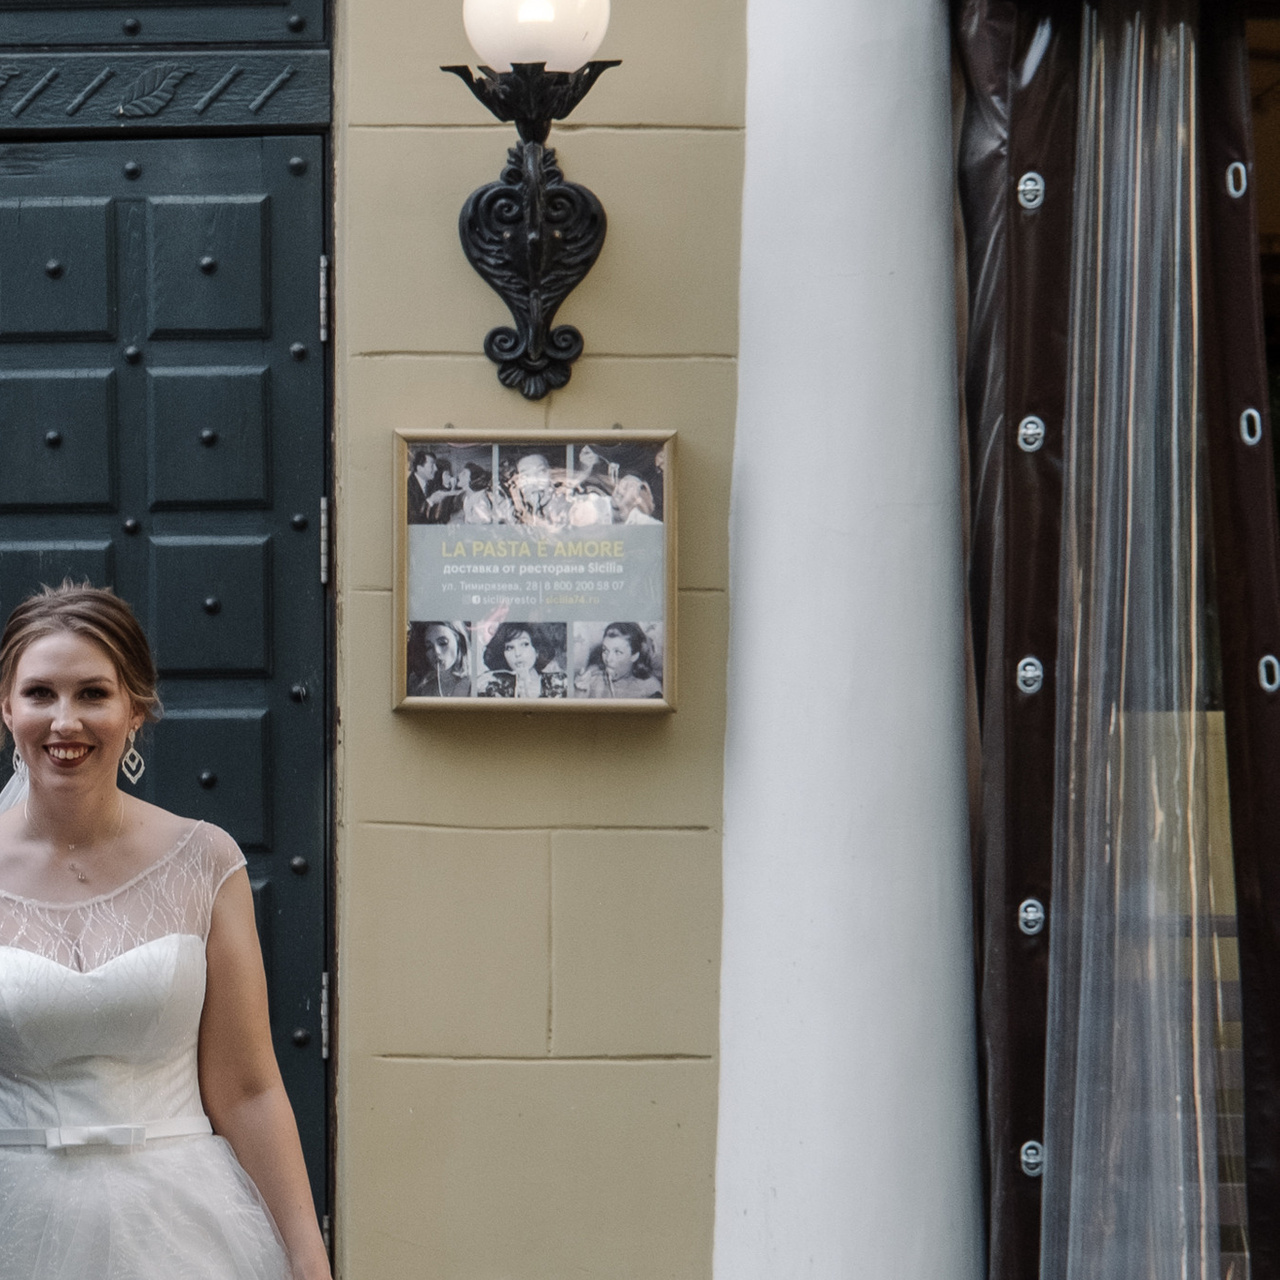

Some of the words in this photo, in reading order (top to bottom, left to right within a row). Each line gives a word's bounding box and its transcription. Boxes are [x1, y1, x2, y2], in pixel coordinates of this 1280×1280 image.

[441, 541, 466, 557] LA
[472, 541, 531, 557] PASTA
[554, 540, 625, 557] AMORE
[443, 564, 500, 575] доставка
[502, 564, 516, 574] от
[519, 564, 585, 576] ресторана
[587, 562, 624, 574] Sicilia
[525, 580, 538, 591] 28
[544, 580, 551, 591] 8
[553, 580, 573, 591] 800
[575, 580, 595, 591] 200
[611, 580, 625, 591] 07
